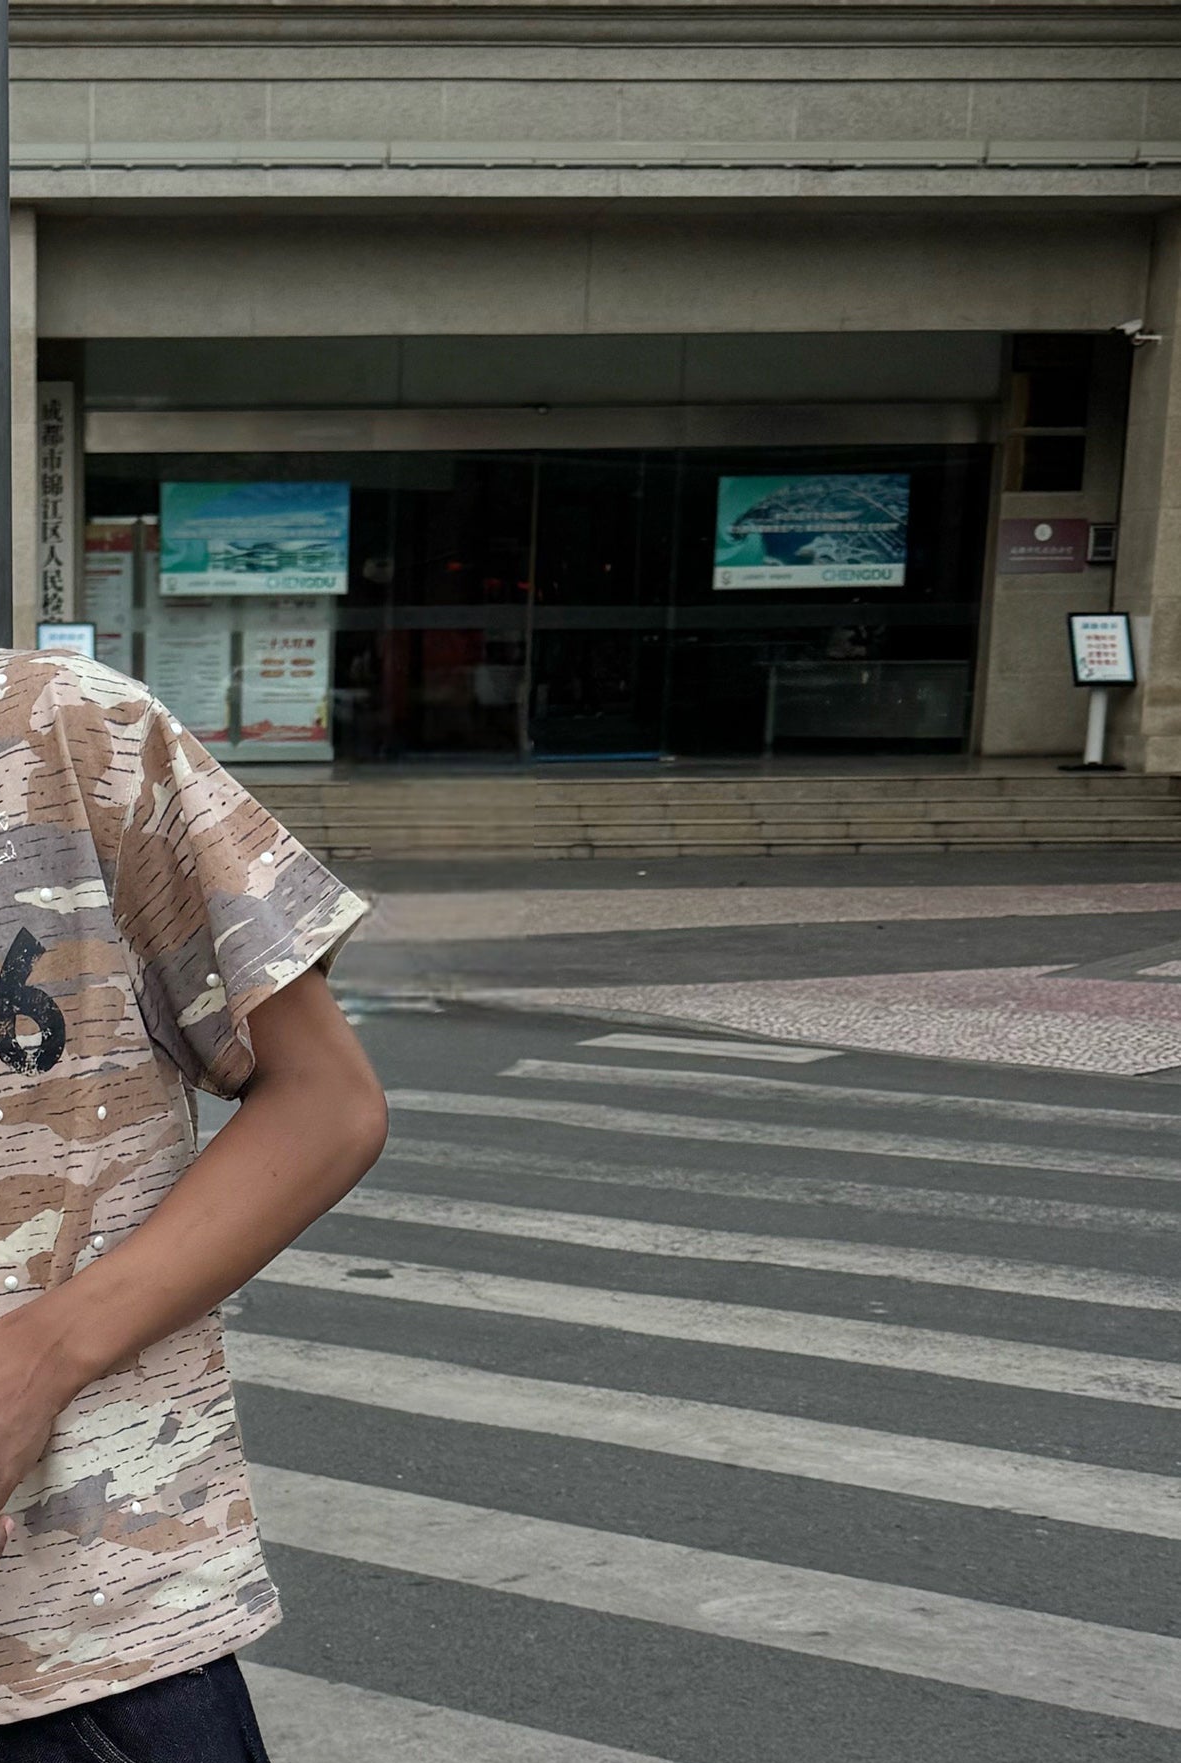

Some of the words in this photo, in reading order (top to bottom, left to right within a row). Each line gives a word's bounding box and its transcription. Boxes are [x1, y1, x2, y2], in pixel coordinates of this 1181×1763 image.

[40, 399, 64, 622] 成都市锦江区人民检
[265, 575, 337, 590] CHENGDU
[821, 568, 893, 582] CHENGDU
